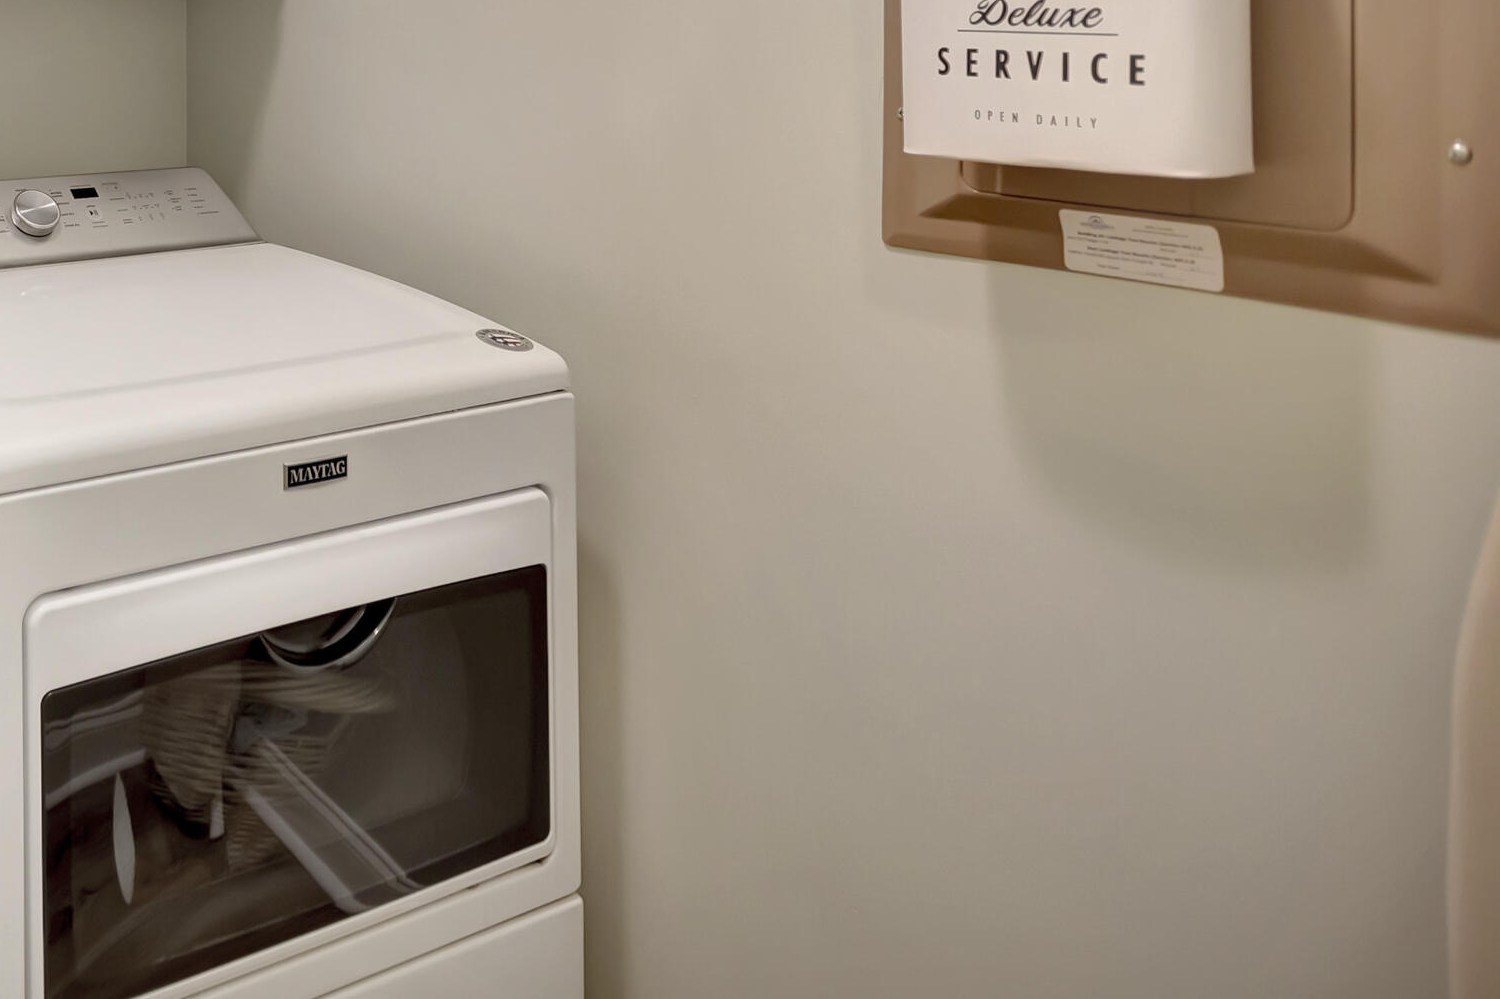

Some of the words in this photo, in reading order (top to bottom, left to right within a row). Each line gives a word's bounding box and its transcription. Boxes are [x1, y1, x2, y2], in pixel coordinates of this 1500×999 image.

[938, 47, 1147, 86] SERVICE
[974, 109, 1019, 123] OPEN
[1036, 114, 1098, 129] DAILY
[289, 460, 346, 484] MAYTAG
